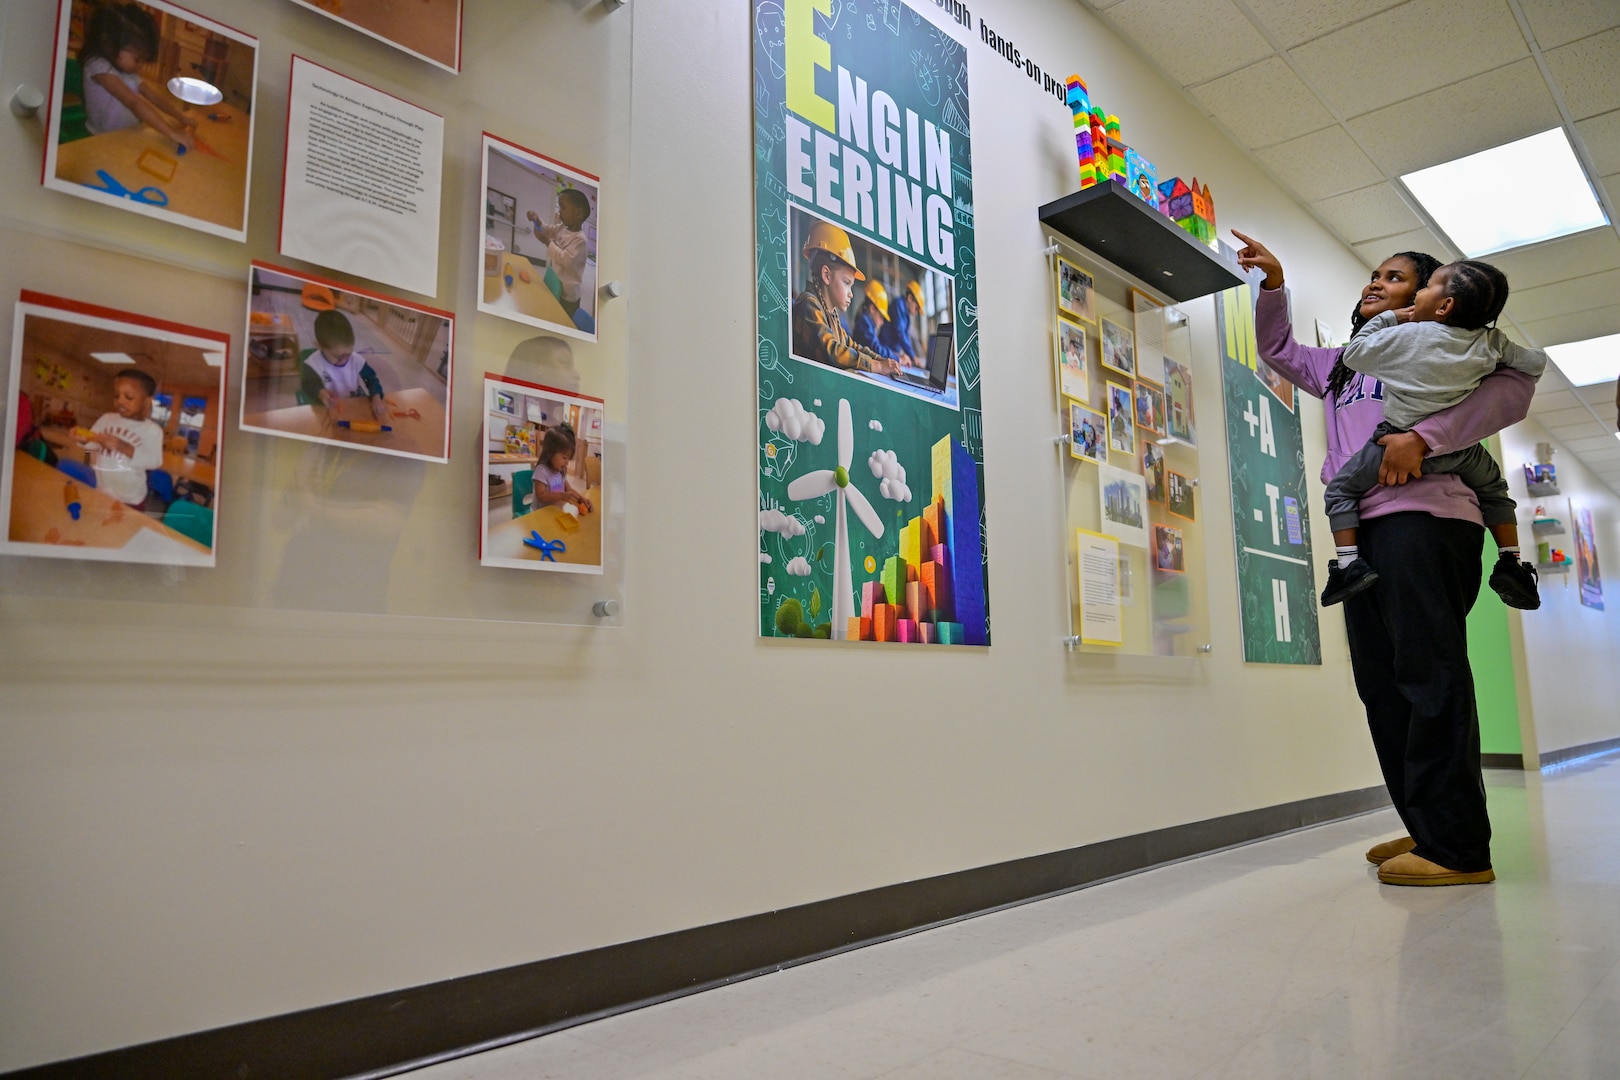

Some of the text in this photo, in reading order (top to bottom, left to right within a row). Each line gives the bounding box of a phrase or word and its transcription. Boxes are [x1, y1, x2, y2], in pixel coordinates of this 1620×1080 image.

[930, 0, 1067, 107] ugh hands-on proj
[786, 114, 955, 270] EERING
[1223, 284, 1257, 371] M
[1272, 578, 1291, 642] H
